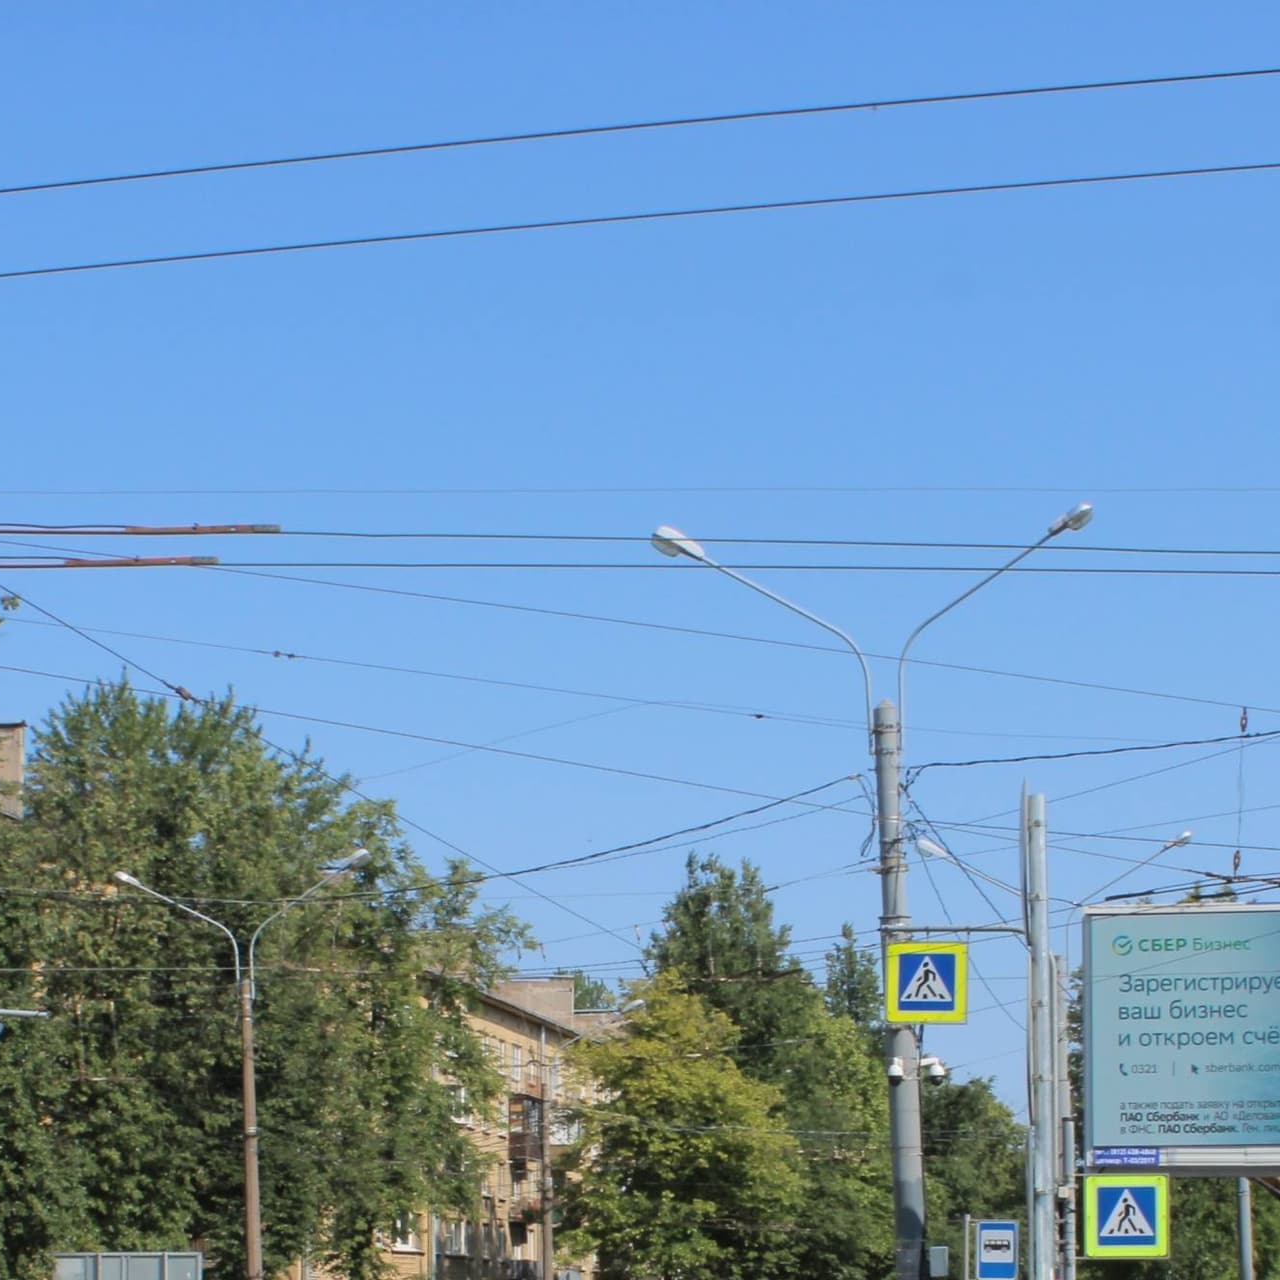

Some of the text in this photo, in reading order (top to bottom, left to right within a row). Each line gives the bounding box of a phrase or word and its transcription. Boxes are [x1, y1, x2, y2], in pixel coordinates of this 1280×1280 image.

[1138, 937, 1251, 951] СБЕР Бизнес
[1118, 1000, 1249, 1020] ваш бизнес
[1118, 1033, 1131, 1047] и
[1138, 1031, 1235, 1050] откроем
[1131, 1064, 1158, 1074] 0321
[1120, 1112, 1143, 1122] ПАО
[1146, 1111, 1199, 1123] Сбербанк
[1158, 1124, 1180, 1134] ПАО
